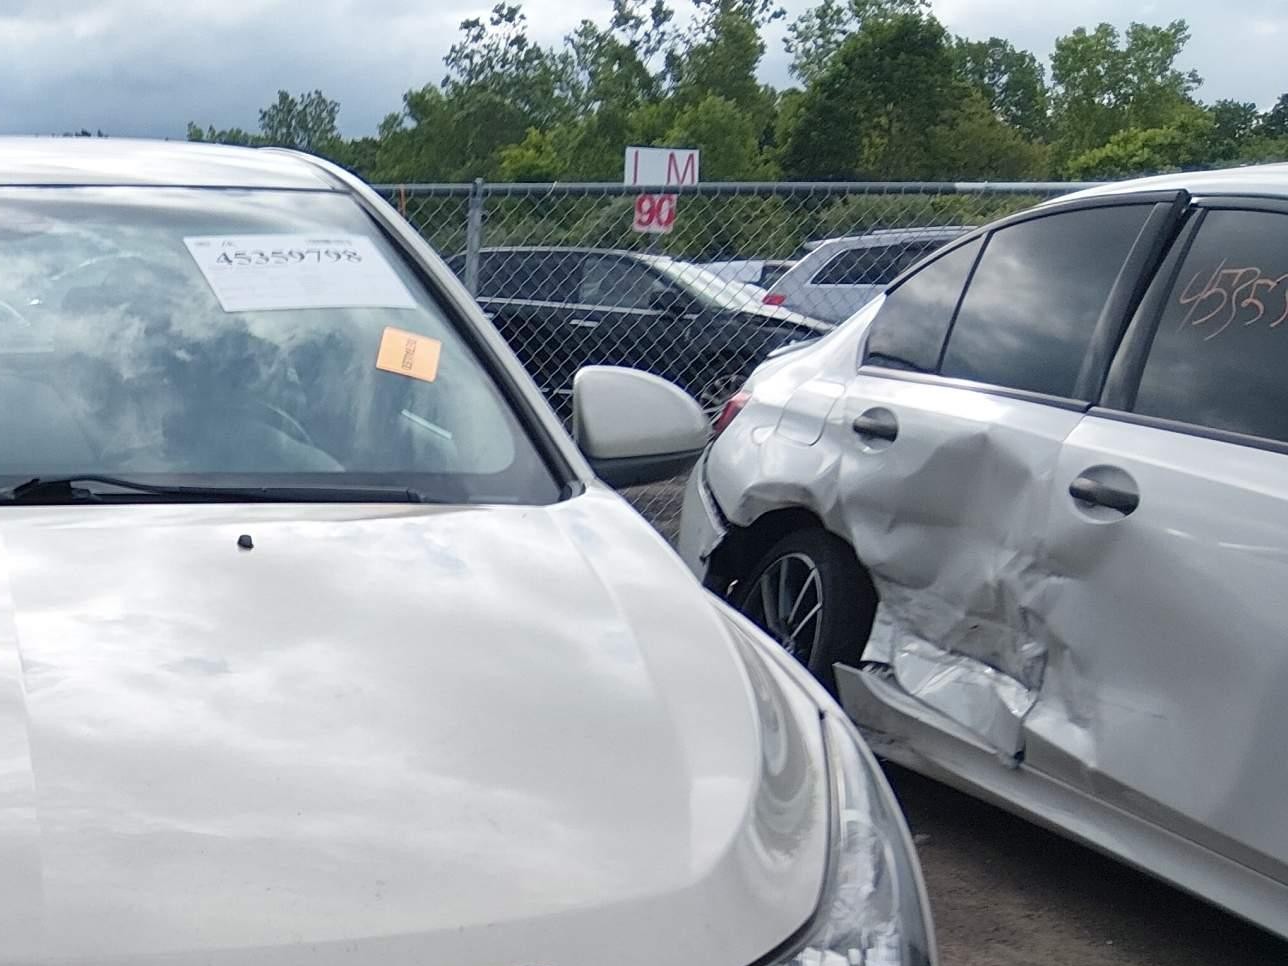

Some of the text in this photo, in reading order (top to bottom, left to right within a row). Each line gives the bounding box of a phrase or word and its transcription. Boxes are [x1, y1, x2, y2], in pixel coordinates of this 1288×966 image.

[666, 151, 697, 185] M
[636, 194, 676, 227] 90
[216, 248, 363, 266] 45359798
